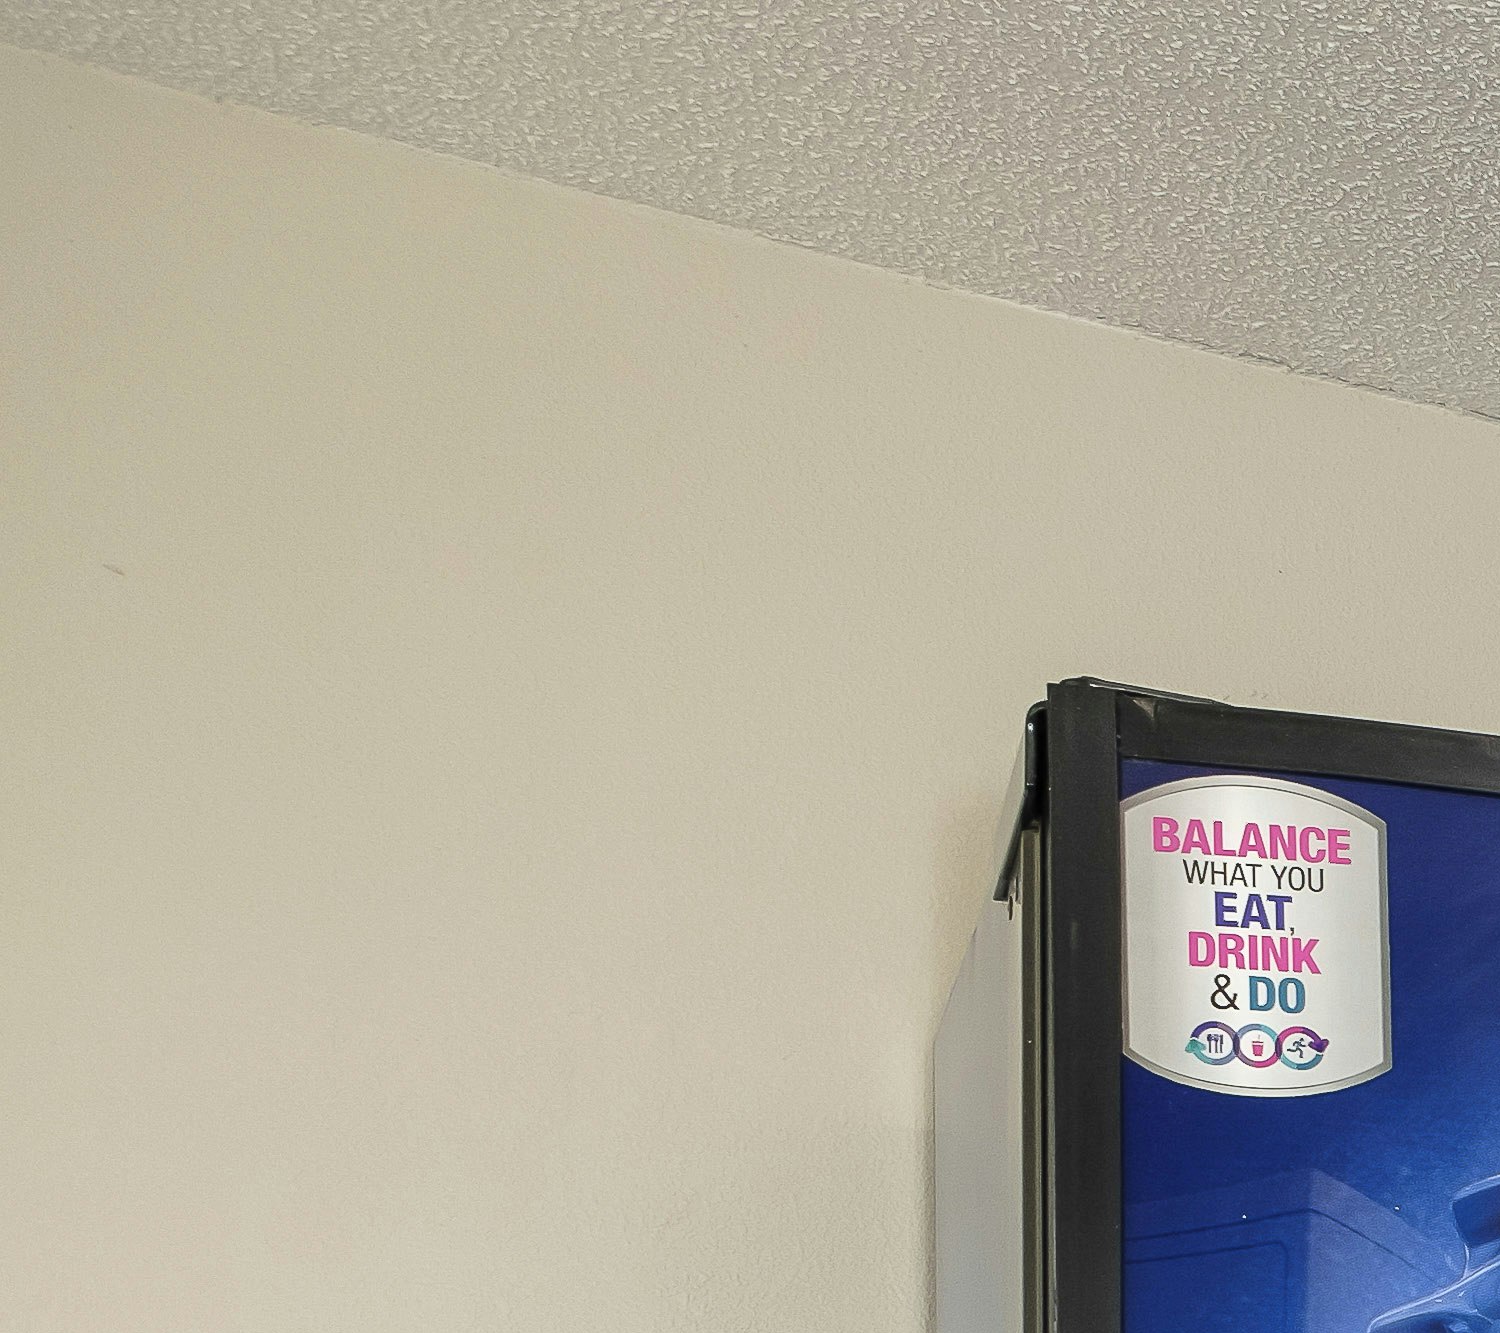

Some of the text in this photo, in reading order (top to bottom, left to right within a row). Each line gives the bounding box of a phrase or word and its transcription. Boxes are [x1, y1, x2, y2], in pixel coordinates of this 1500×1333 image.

[1153, 817, 1351, 864] BALANCE
[1183, 860, 1324, 892] WHAT YOU
[1215, 892, 1295, 936] EAT,
[1189, 932, 1321, 974] DRINK
[1211, 974, 1306, 1014] & DO
